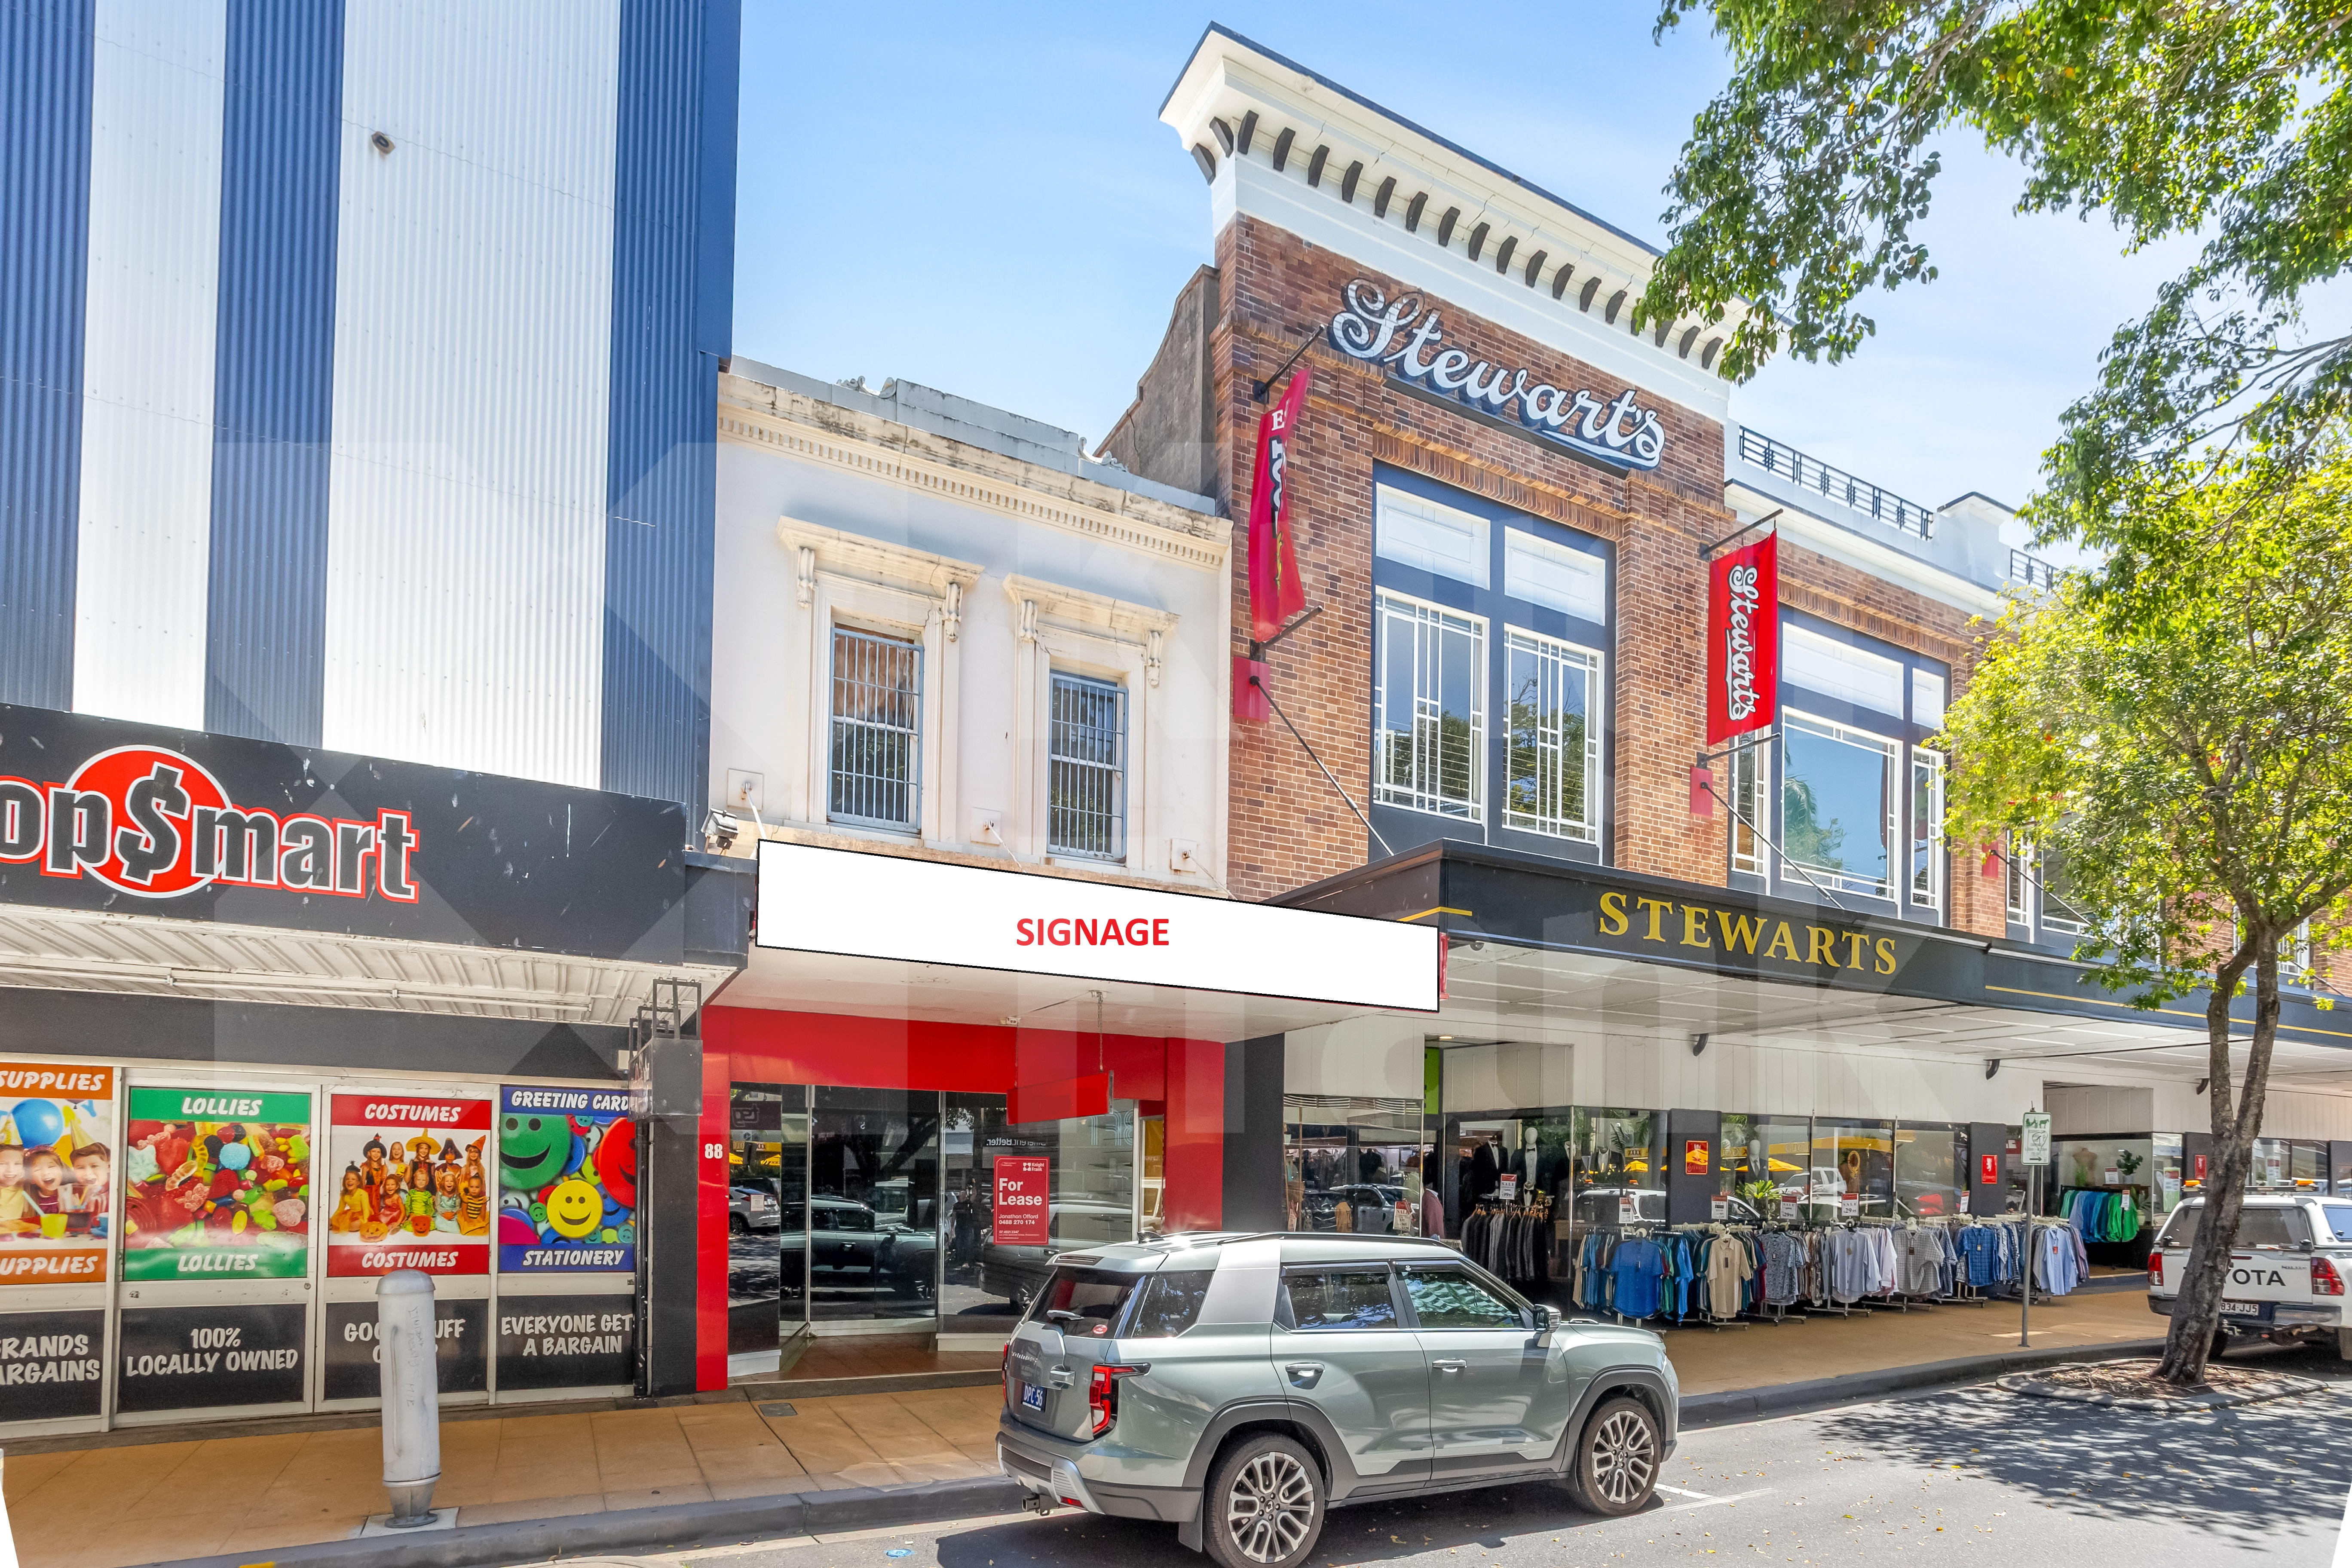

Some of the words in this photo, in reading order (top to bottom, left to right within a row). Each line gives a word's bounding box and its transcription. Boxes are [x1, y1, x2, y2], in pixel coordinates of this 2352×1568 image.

[1599, 892, 1896, 975] STEWARTS
[182, 1097, 262, 1116] LOLLIES
[511, 1091, 588, 1109] GREETING
[364, 1103, 461, 1122] COSTUMES
[704, 1143, 723, 1159] 88
[999, 1178, 1023, 1191] For
[999, 1192, 1042, 1206] Lease
[177, 1254, 259, 1272] LOLLIES
[361, 1251, 458, 1269] COSTUMES
[523, 1250, 625, 1266] STATIONERY
[501, 1314, 596, 1336] EVERYONE
[601, 1313, 634, 1332] GET
[0, 1334, 89, 1360] RANDS
[190, 1328, 241, 1349] 100%
[523, 1338, 538, 1356] A
[542, 1335, 622, 1355] BARGAIN
[127, 1352, 220, 1377] LOCALLY
[225, 1349, 298, 1370] OWNED
